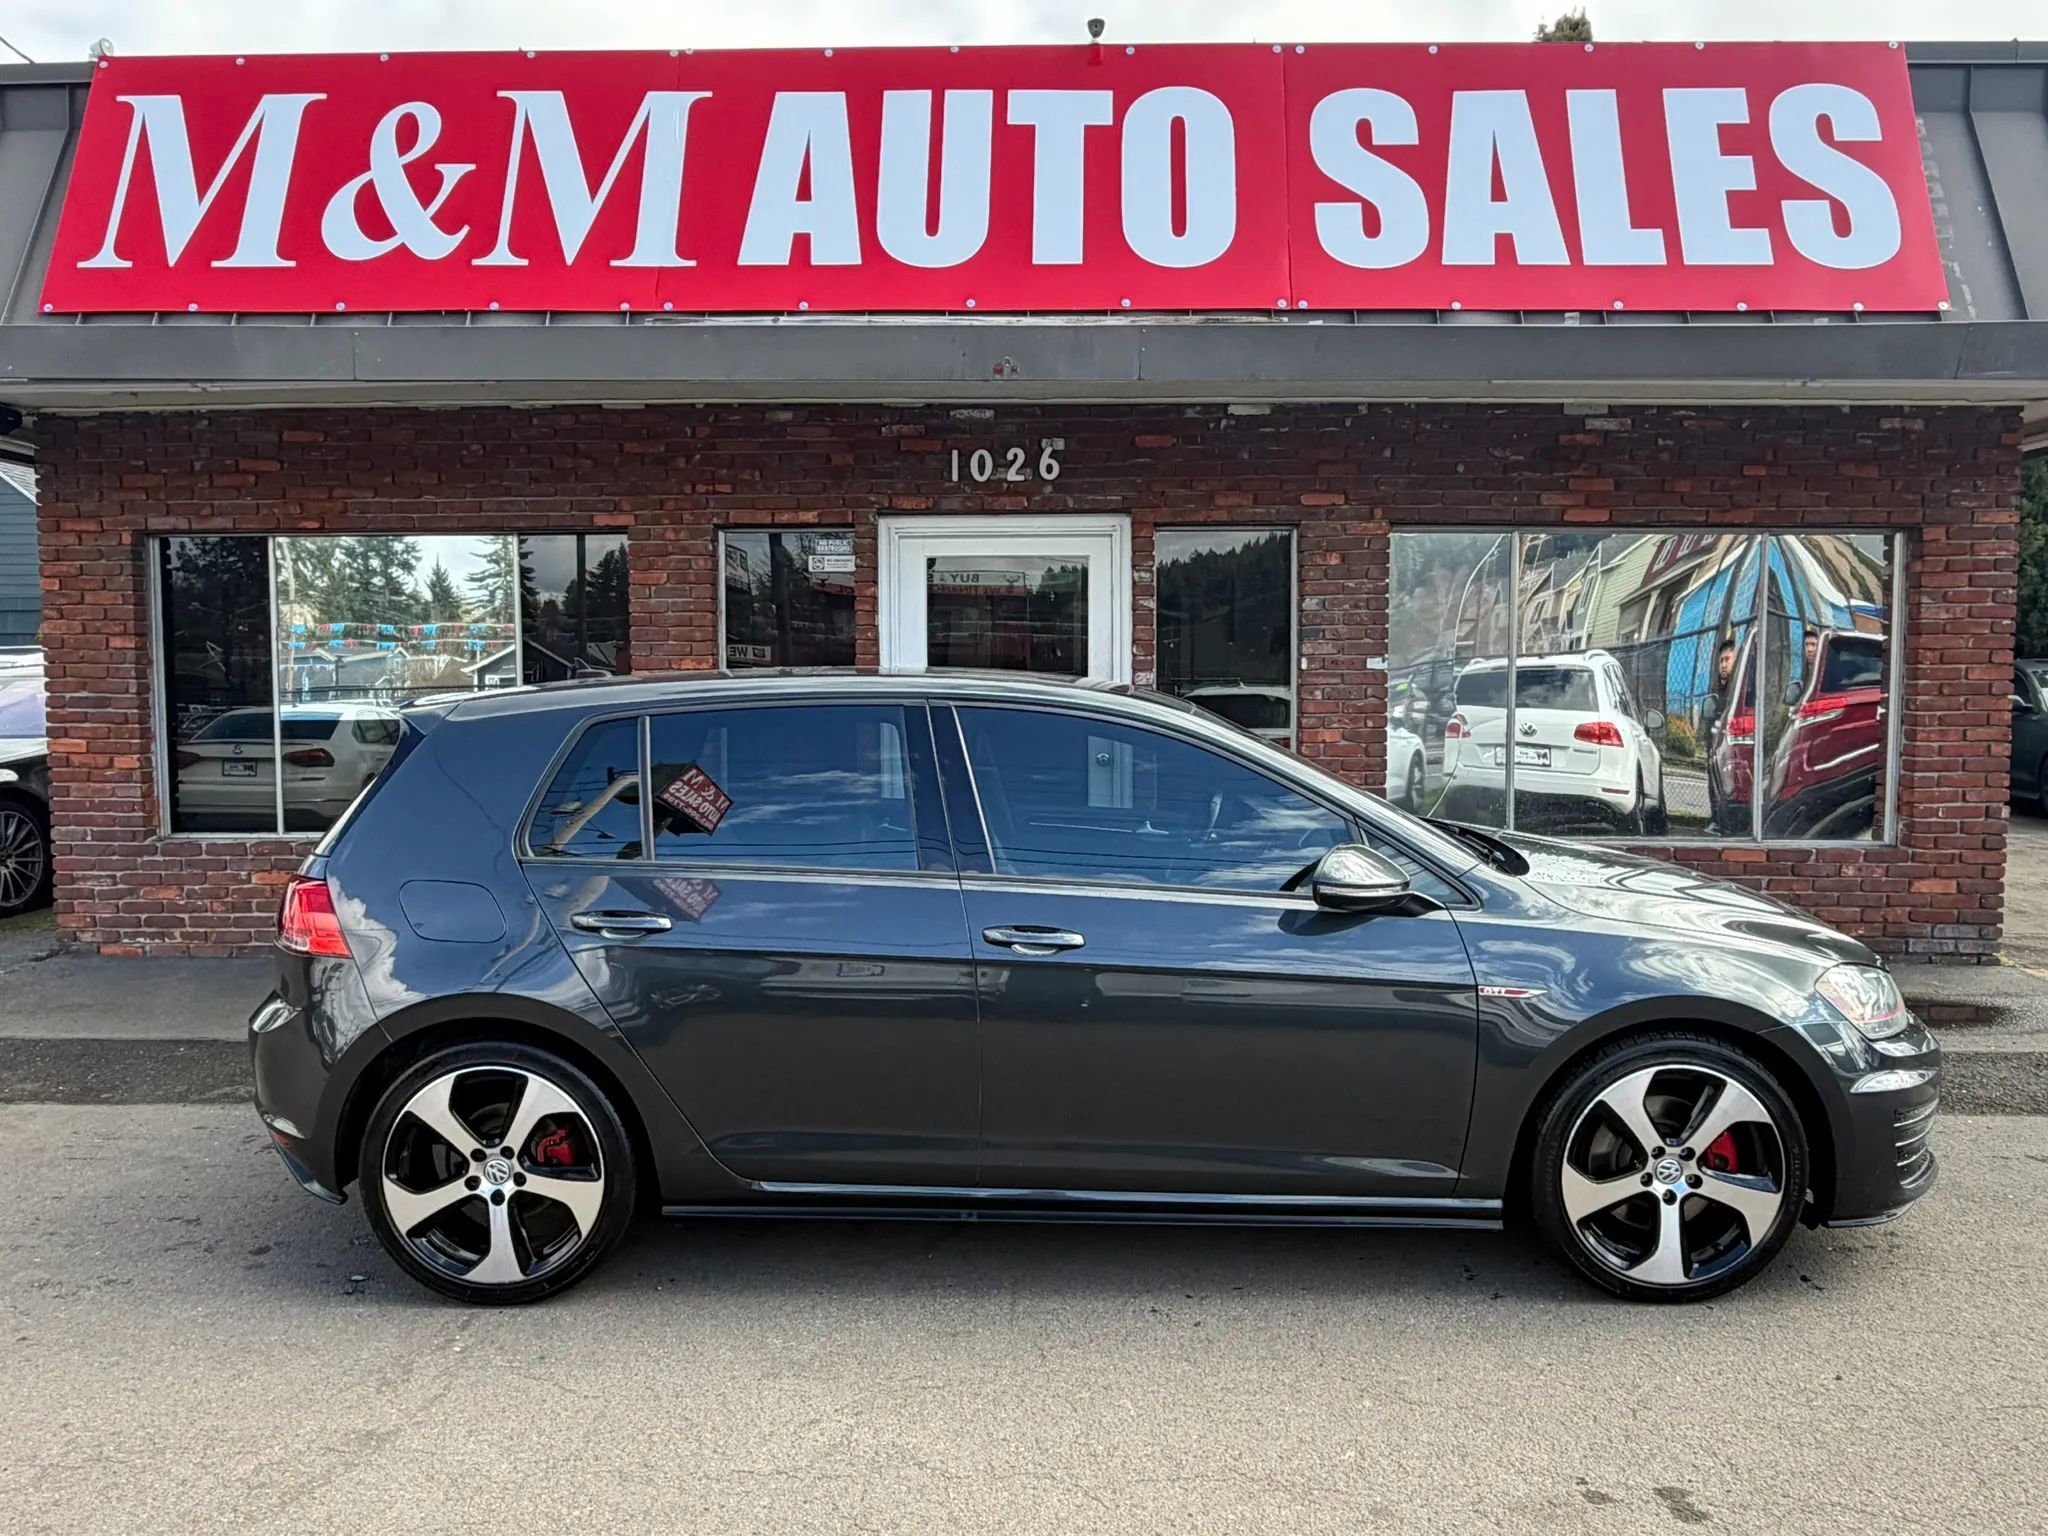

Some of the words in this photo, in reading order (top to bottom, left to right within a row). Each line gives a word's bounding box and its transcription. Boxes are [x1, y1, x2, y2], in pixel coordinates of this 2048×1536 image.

[736, 86, 1237, 268] AUTO
[1309, 83, 1902, 270] SALES
[951, 446, 1060, 482] 1026
